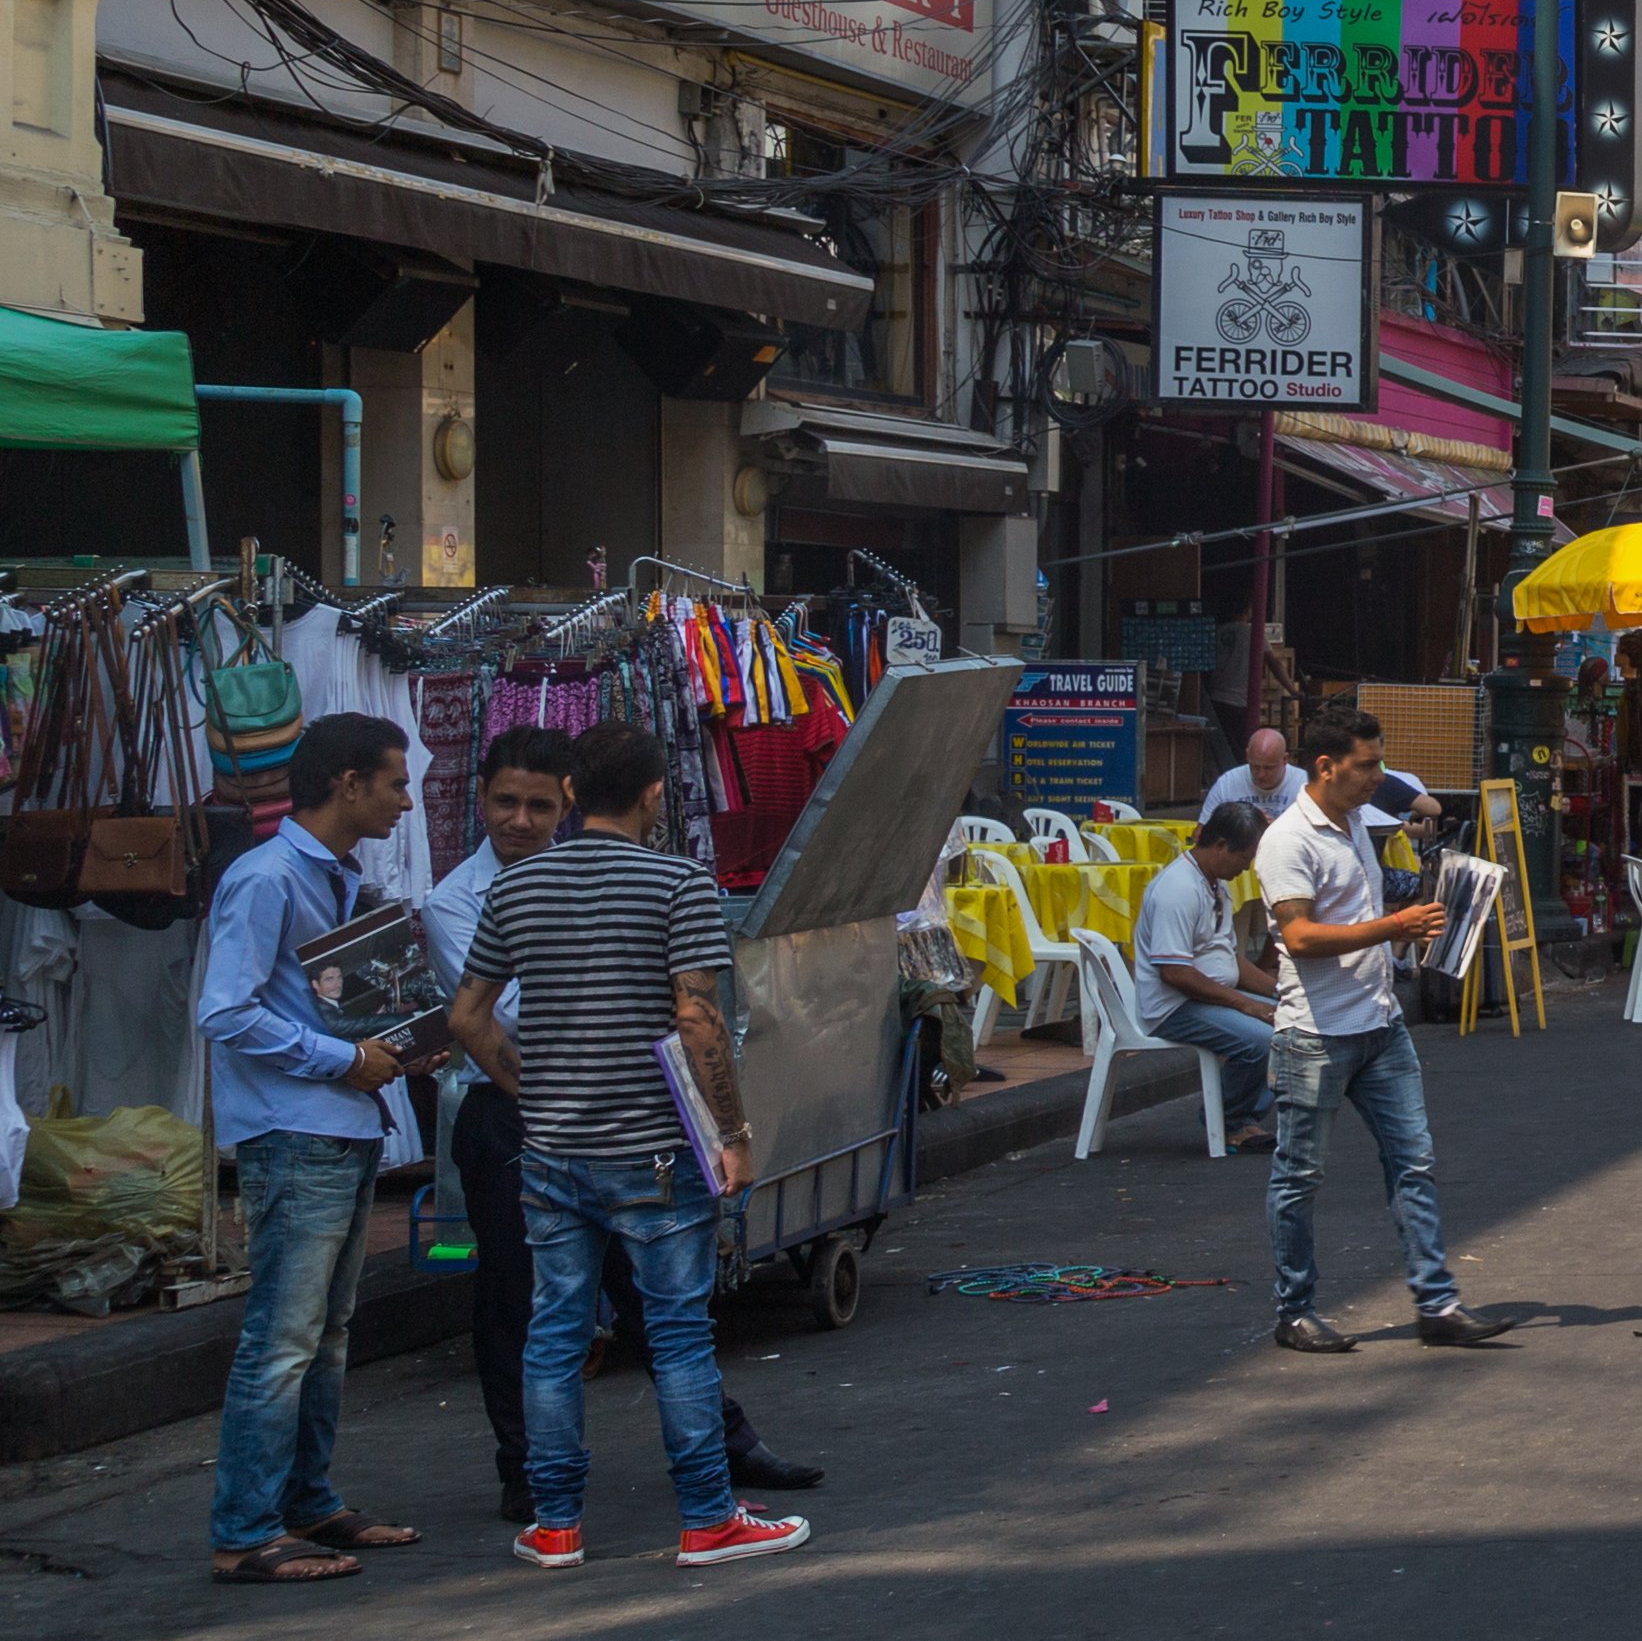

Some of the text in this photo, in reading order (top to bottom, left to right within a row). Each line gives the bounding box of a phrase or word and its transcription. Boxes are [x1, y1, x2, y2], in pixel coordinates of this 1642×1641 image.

[1318, 1, 1383, 23] Style
[872, 16, 887, 54] &
[892, 19, 974, 82] Restaurant
[1179, 208, 1356, 226] Luxury Tattoo Shop & Gallery Rich Boy Style
[1174, 345, 1353, 378] FERRIDER
[1173, 376, 1342, 399] TATTOO Studio
[1049, 674, 1134, 692] TRAVEL GUIDE
[1015, 699, 1126, 707] KHAOSAN BRANCH
[1012, 737, 1069, 748] WORLDWIDE
[1013, 755, 1045, 766] HOTEL
[1050, 777, 1074, 785] TRAIN
[1076, 777, 1103, 785] TICKET
[1048, 795, 1071, 803] SIGHT
